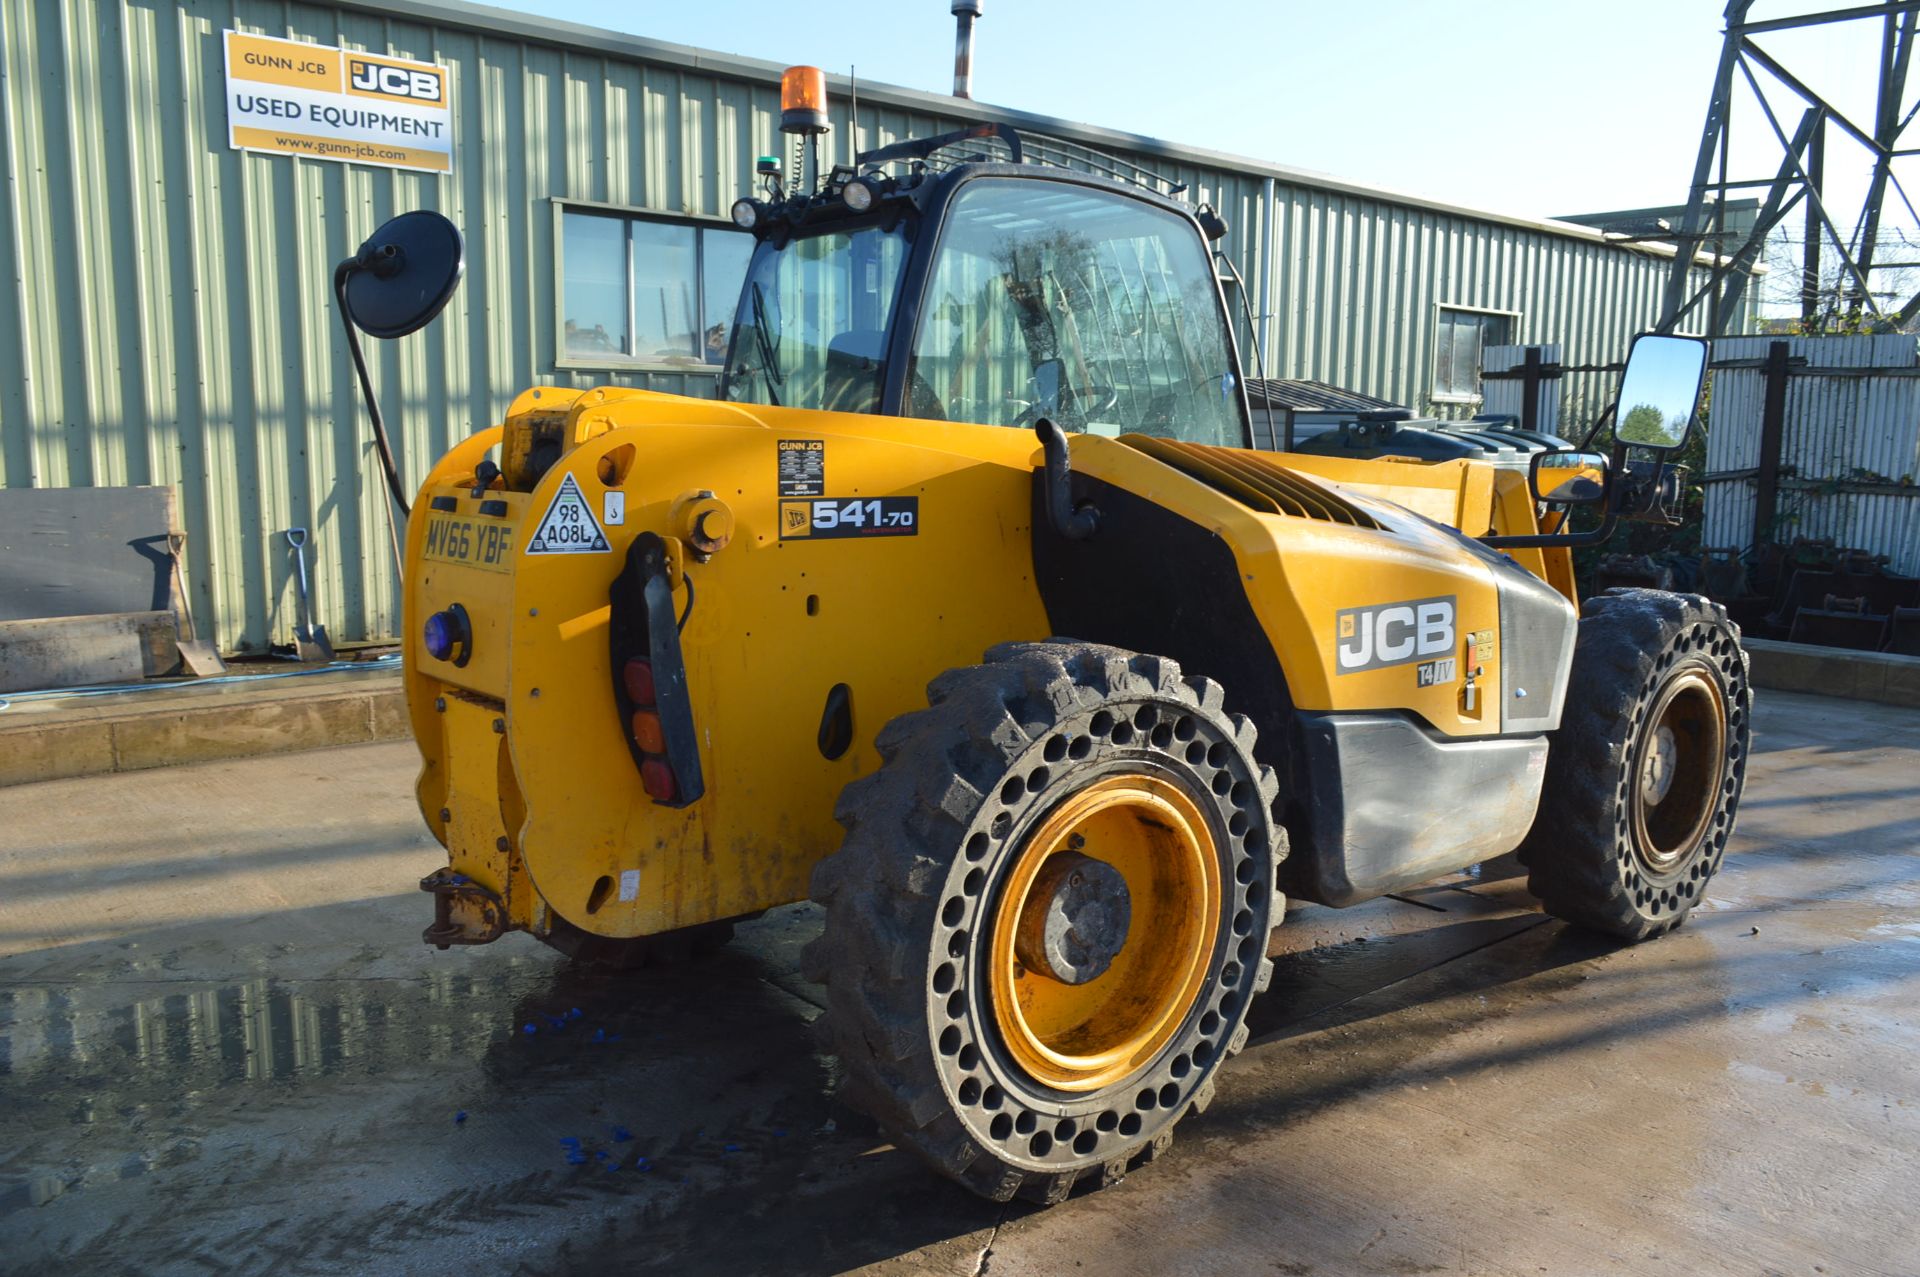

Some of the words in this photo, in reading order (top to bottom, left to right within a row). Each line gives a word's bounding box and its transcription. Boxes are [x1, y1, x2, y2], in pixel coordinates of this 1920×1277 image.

[244, 52, 292, 70] GUNN
[297, 62, 326, 75] JCB
[353, 65, 440, 99] JCB
[236, 94, 302, 119] USED
[310, 104, 443, 138] EQUIPMENT
[275, 137, 406, 161] www.gunn-jcb.com
[559, 504, 579, 523] 98
[813, 500, 913, 529] 541-70
[426, 519, 472, 559] MV66
[475, 524, 512, 564] YBF
[1339, 601, 1454, 668] JCB
